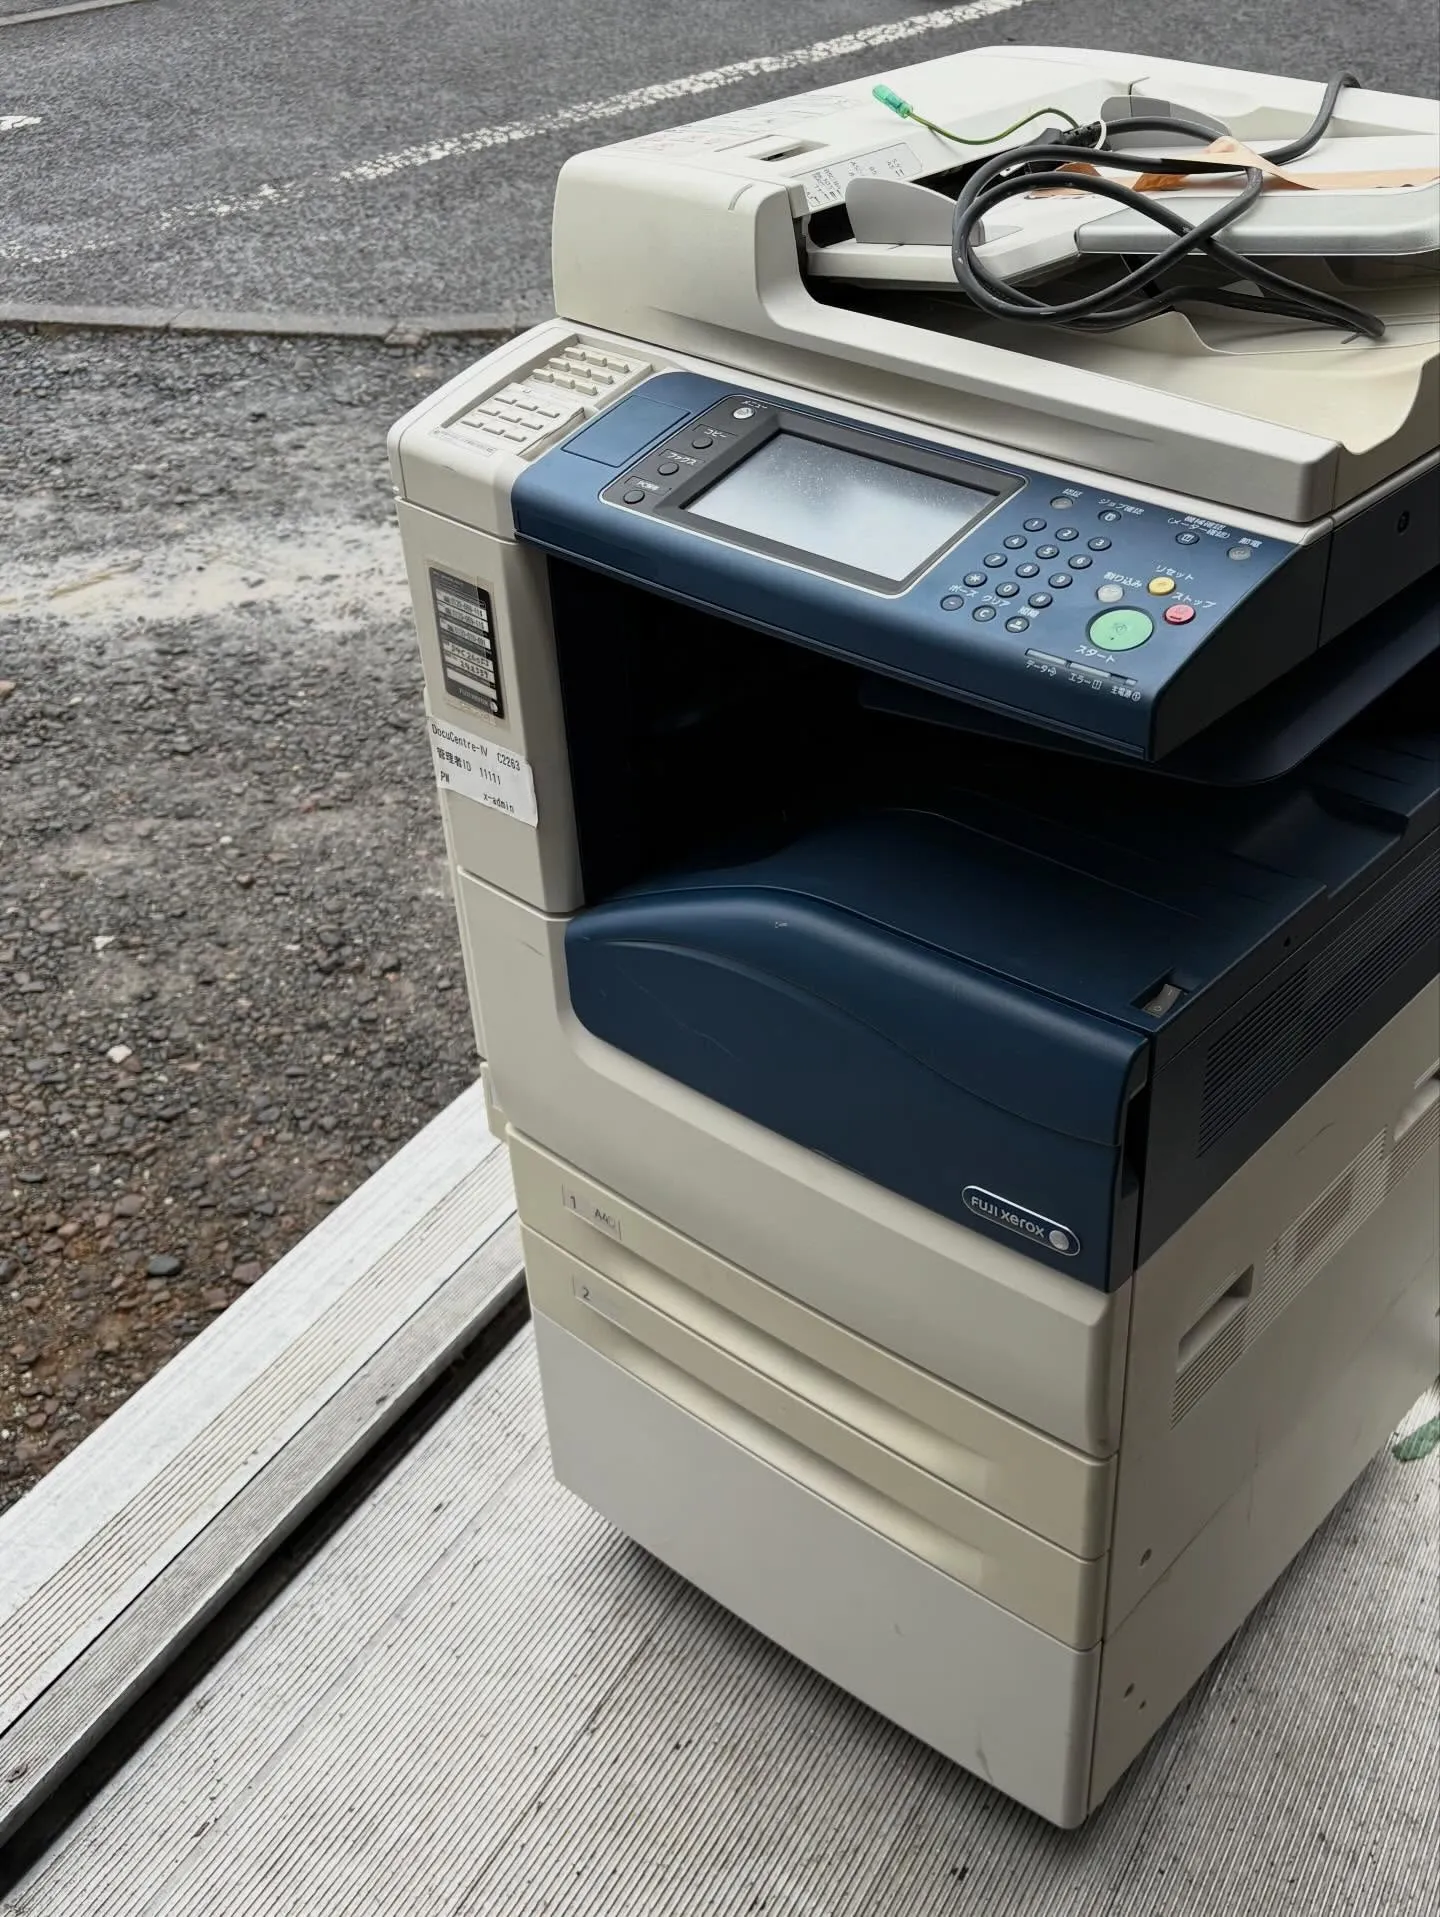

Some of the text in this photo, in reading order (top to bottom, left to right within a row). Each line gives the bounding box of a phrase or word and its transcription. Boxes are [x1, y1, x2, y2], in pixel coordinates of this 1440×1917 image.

[704, 428, 727, 438] コピー
[1098, 498, 1145, 515] ジョブ確認
[1103, 571, 1142, 588] 割り込み
[1155, 565, 1194, 581] リセット
[981, 595, 1011, 607] クリア
[1172, 592, 1217, 608] ストップ
[1075, 645, 1116, 664] スタート
[1026, 660, 1048, 673] データ
[1068, 672, 1091, 685] エラー
[1110, 685, 1132, 699] 主電源
[437, 747, 472, 772] 管理者ID
[496, 752, 521, 772] C2263
[483, 793, 515, 814] x-admin
[569, 1195, 577, 1209] 1
[970, 1195, 1045, 1238] FUJI xerox
[582, 1286, 591, 1301] 2
